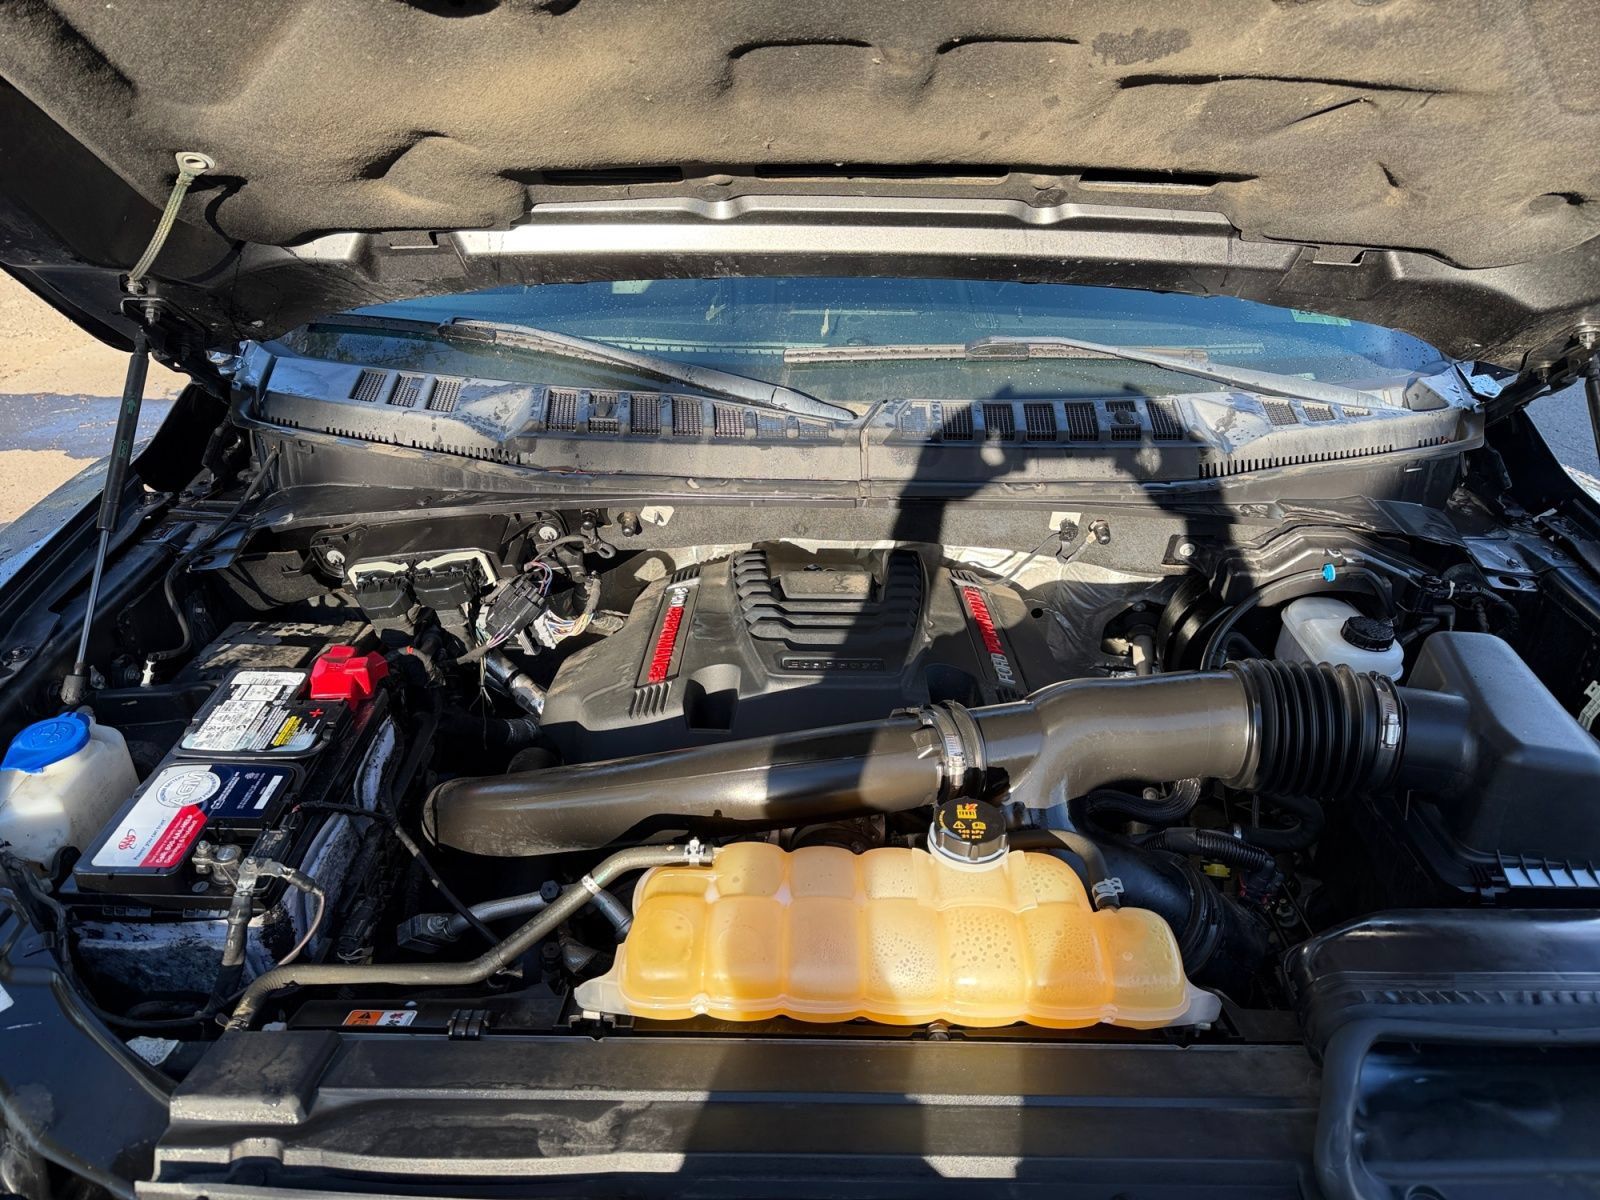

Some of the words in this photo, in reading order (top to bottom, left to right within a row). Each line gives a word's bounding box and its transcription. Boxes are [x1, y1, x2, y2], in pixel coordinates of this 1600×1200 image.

[963, 586, 1007, 655] PERFORMANCE
[648, 606, 684, 683] PERFORMANCE
[991, 653, 1016, 685] FORD
[168, 772, 202, 806] AGM
[118, 835, 136, 850] AAA
[133, 846, 145, 860] Power
[156, 819, 166, 829] trust
